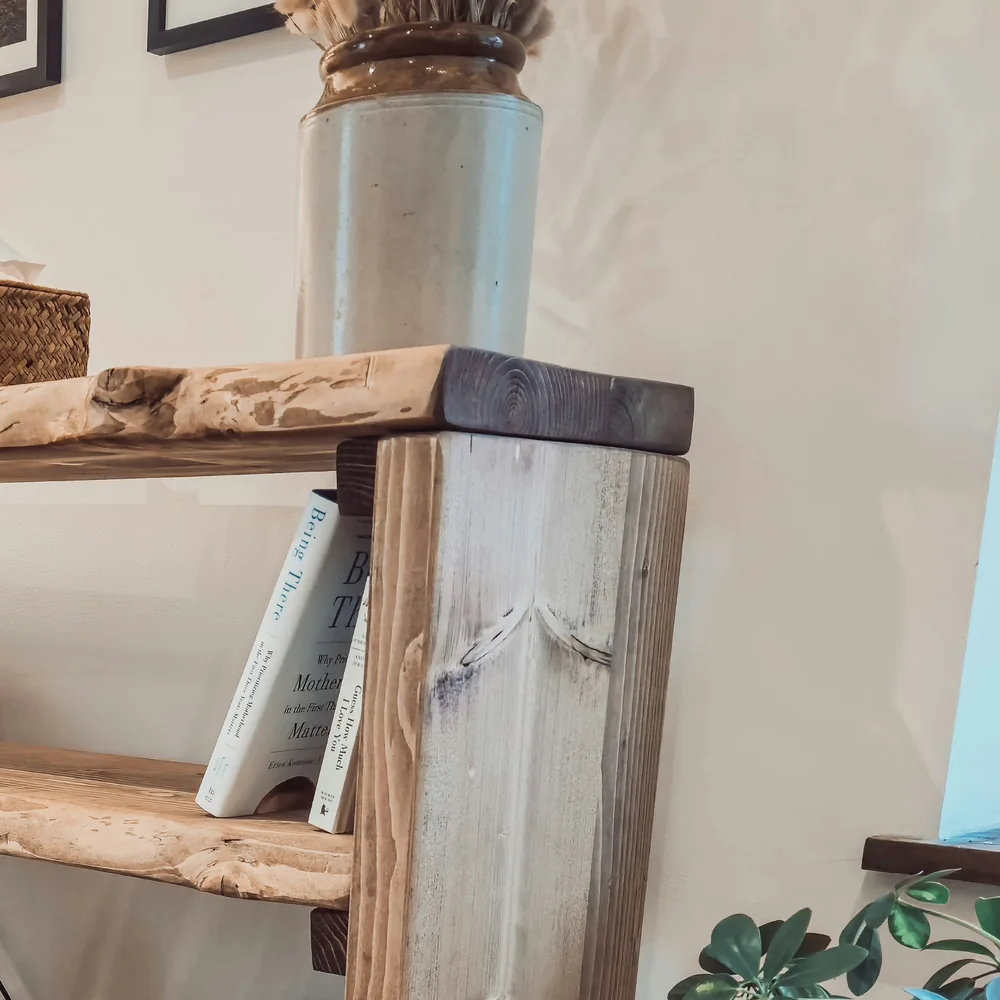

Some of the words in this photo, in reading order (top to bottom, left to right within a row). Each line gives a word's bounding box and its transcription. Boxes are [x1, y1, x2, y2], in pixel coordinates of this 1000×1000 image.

[293, 507, 327, 560] Being
[272, 570, 303, 621] There
[316, 654, 333, 667] Why
[283, 704, 292, 714] in
[349, 685, 362, 714] Guess
[336, 706, 348, 730] Love
[343, 717, 355, 741] How
[288, 721, 331, 740] Matte
[330, 733, 342, 752] You
[335, 743, 348, 771] Much
